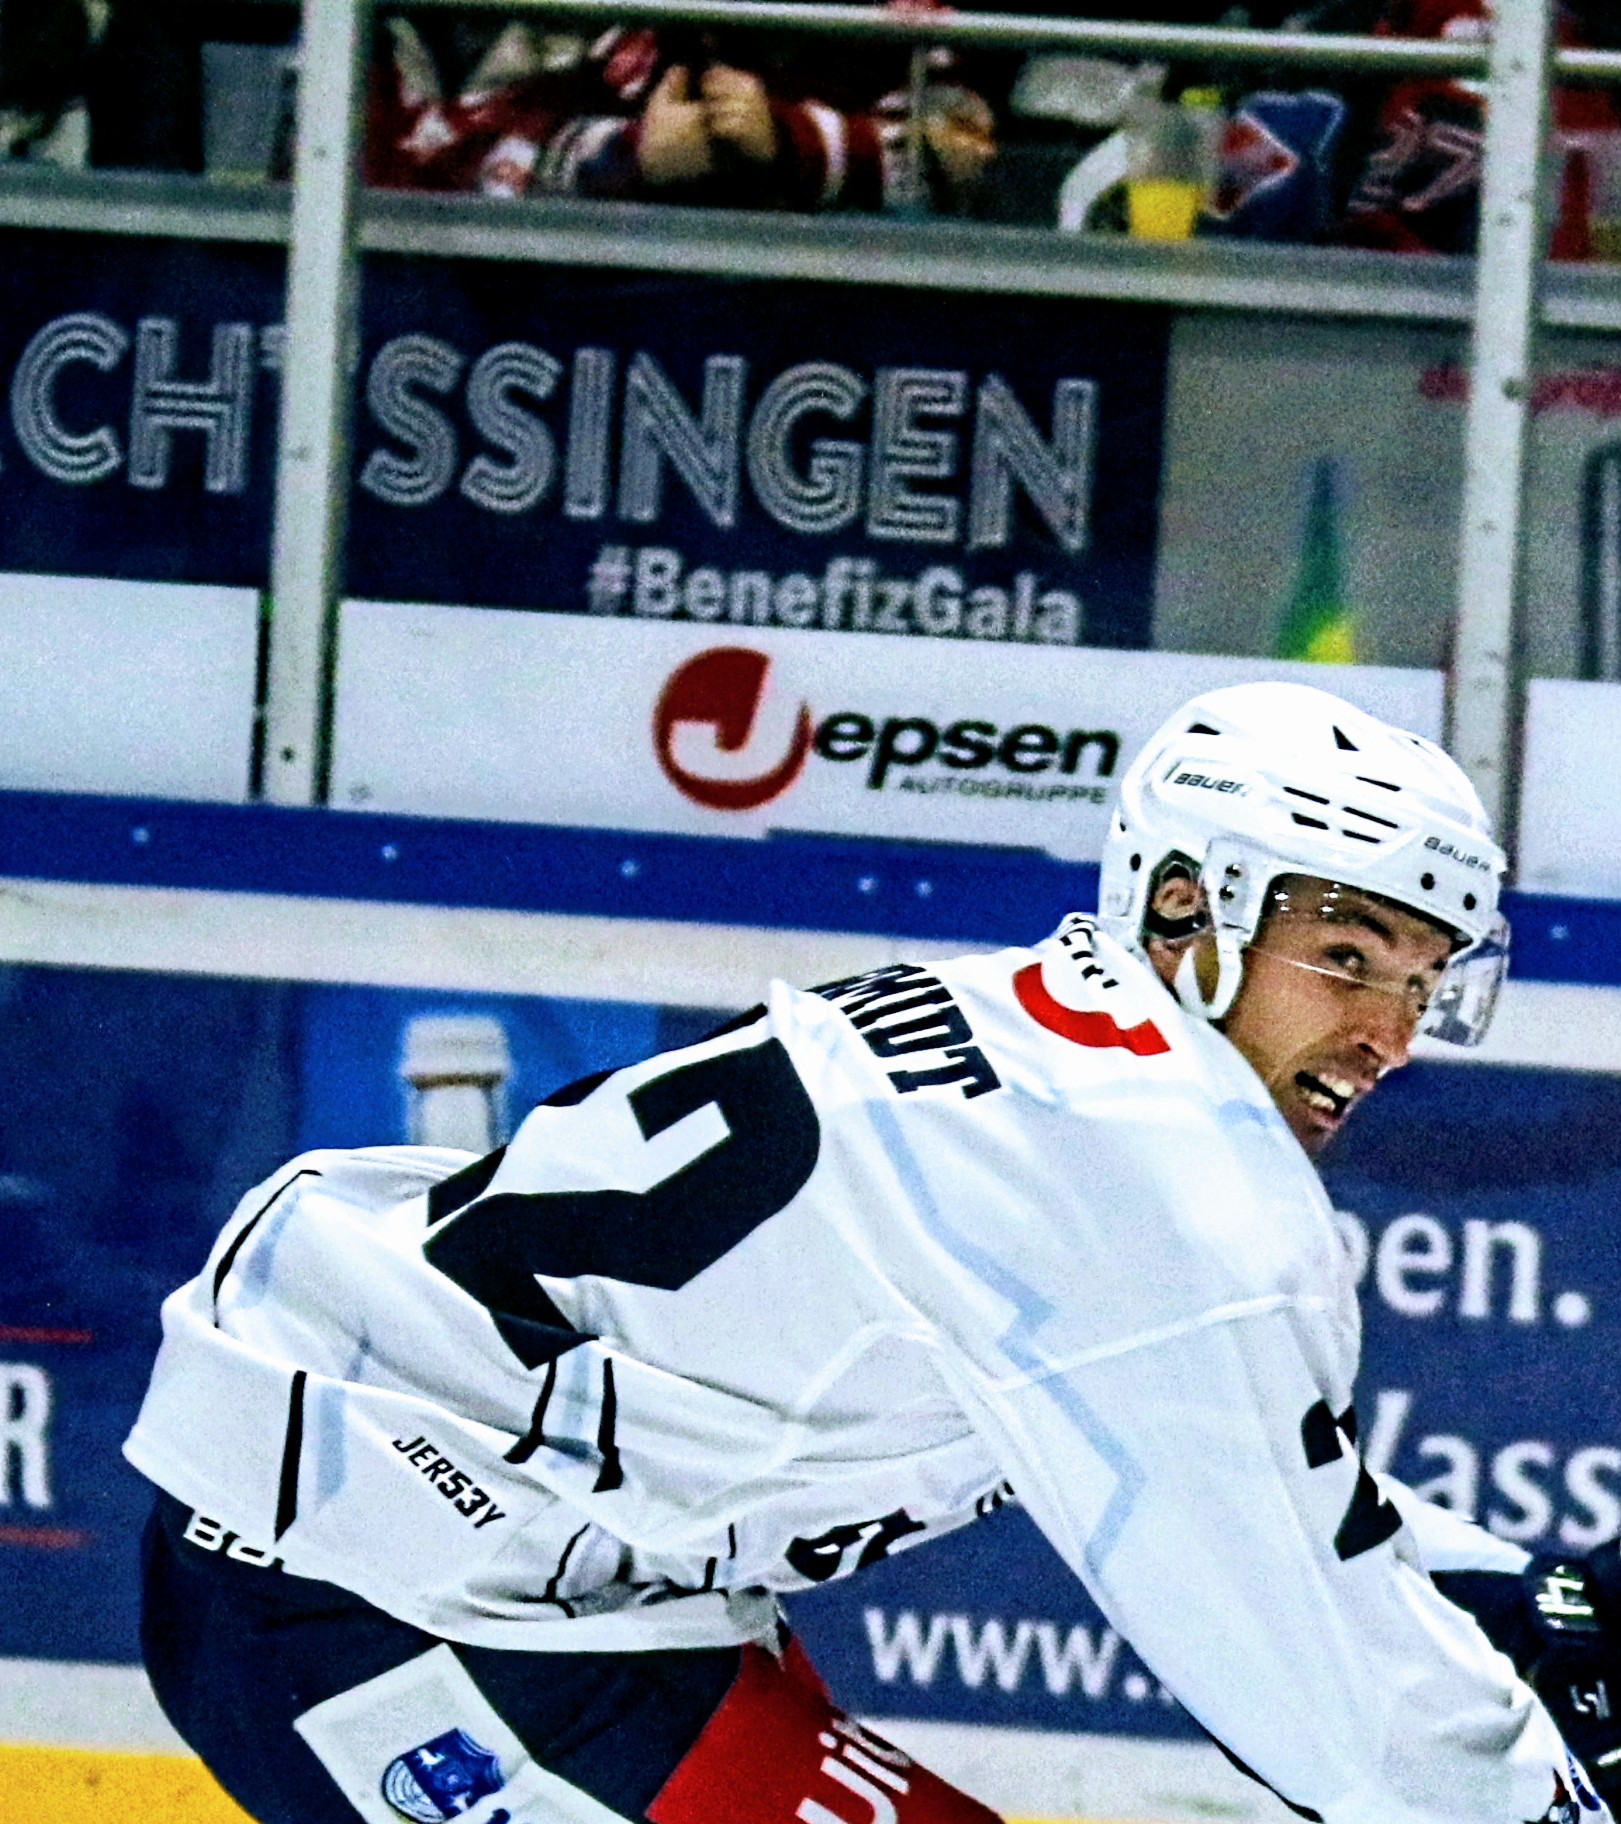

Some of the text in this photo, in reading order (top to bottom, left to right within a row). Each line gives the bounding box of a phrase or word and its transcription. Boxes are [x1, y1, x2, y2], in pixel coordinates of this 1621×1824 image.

[11, 311, 1099, 556] CHSSINGEN
[588, 543, 1081, 647] #BenefizGala
[864, 1604, 1176, 1706] www.
